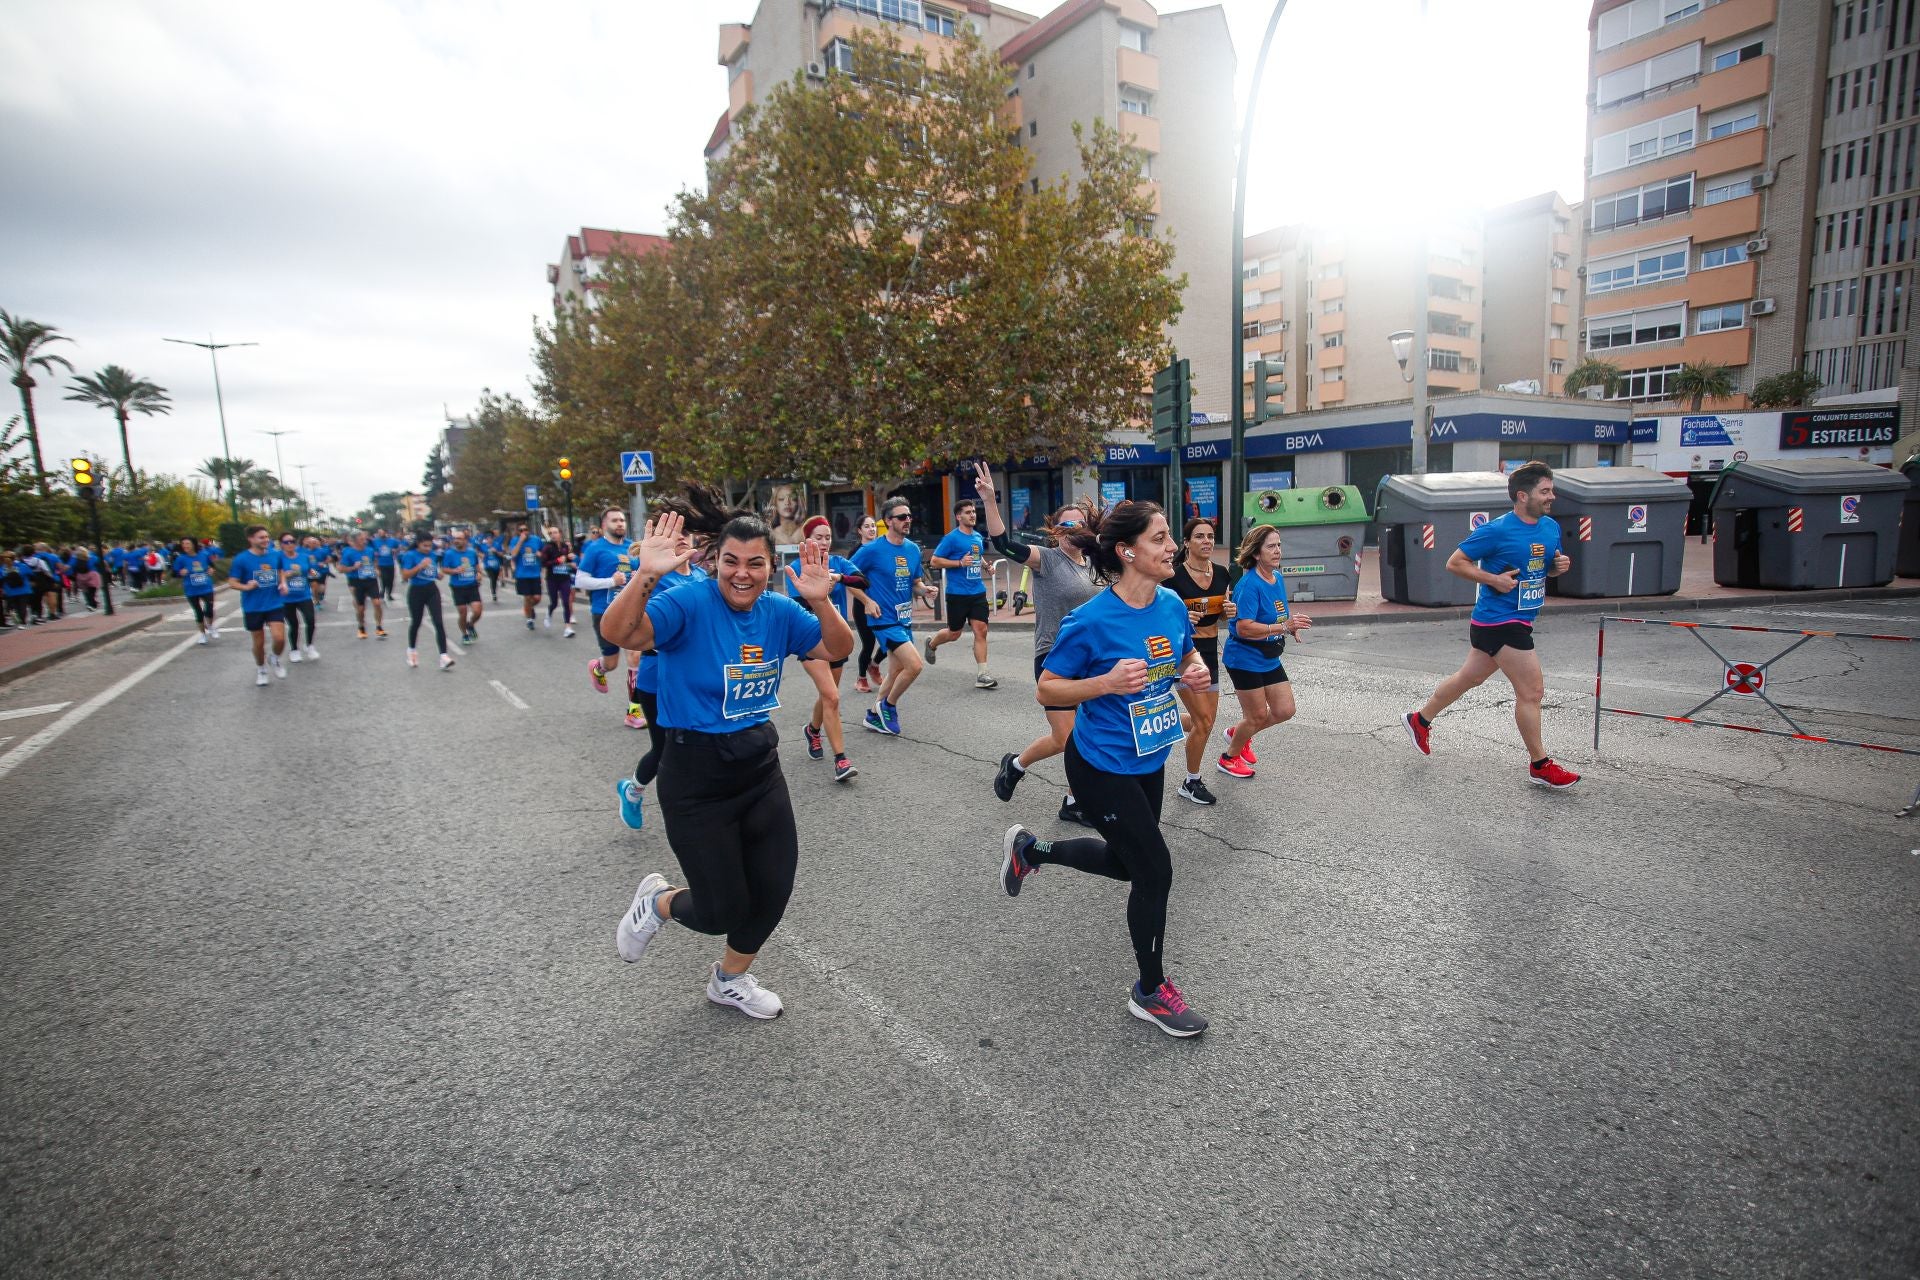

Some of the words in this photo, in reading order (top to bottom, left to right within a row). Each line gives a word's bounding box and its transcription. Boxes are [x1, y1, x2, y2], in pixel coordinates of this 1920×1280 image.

[1683, 419, 1719, 429] Fachadas
[1721, 418, 1743, 428] Serna
[1812, 414, 1848, 422] CONJUNTO
[1849, 411, 1894, 420] RESIDENCIAL
[1501, 420, 1527, 435] BBVA
[1594, 424, 1615, 438] BBVA
[1633, 428, 1654, 436] BBVA
[1787, 416, 1810, 446] 5
[1811, 427, 1893, 444] ESTRELLAS
[1286, 432, 1324, 450] BBVA
[1109, 447, 1139, 460] BBVA
[1187, 443, 1218, 459] BBVA
[732, 678, 776, 700] 1237
[1139, 709, 1178, 736] 4059
